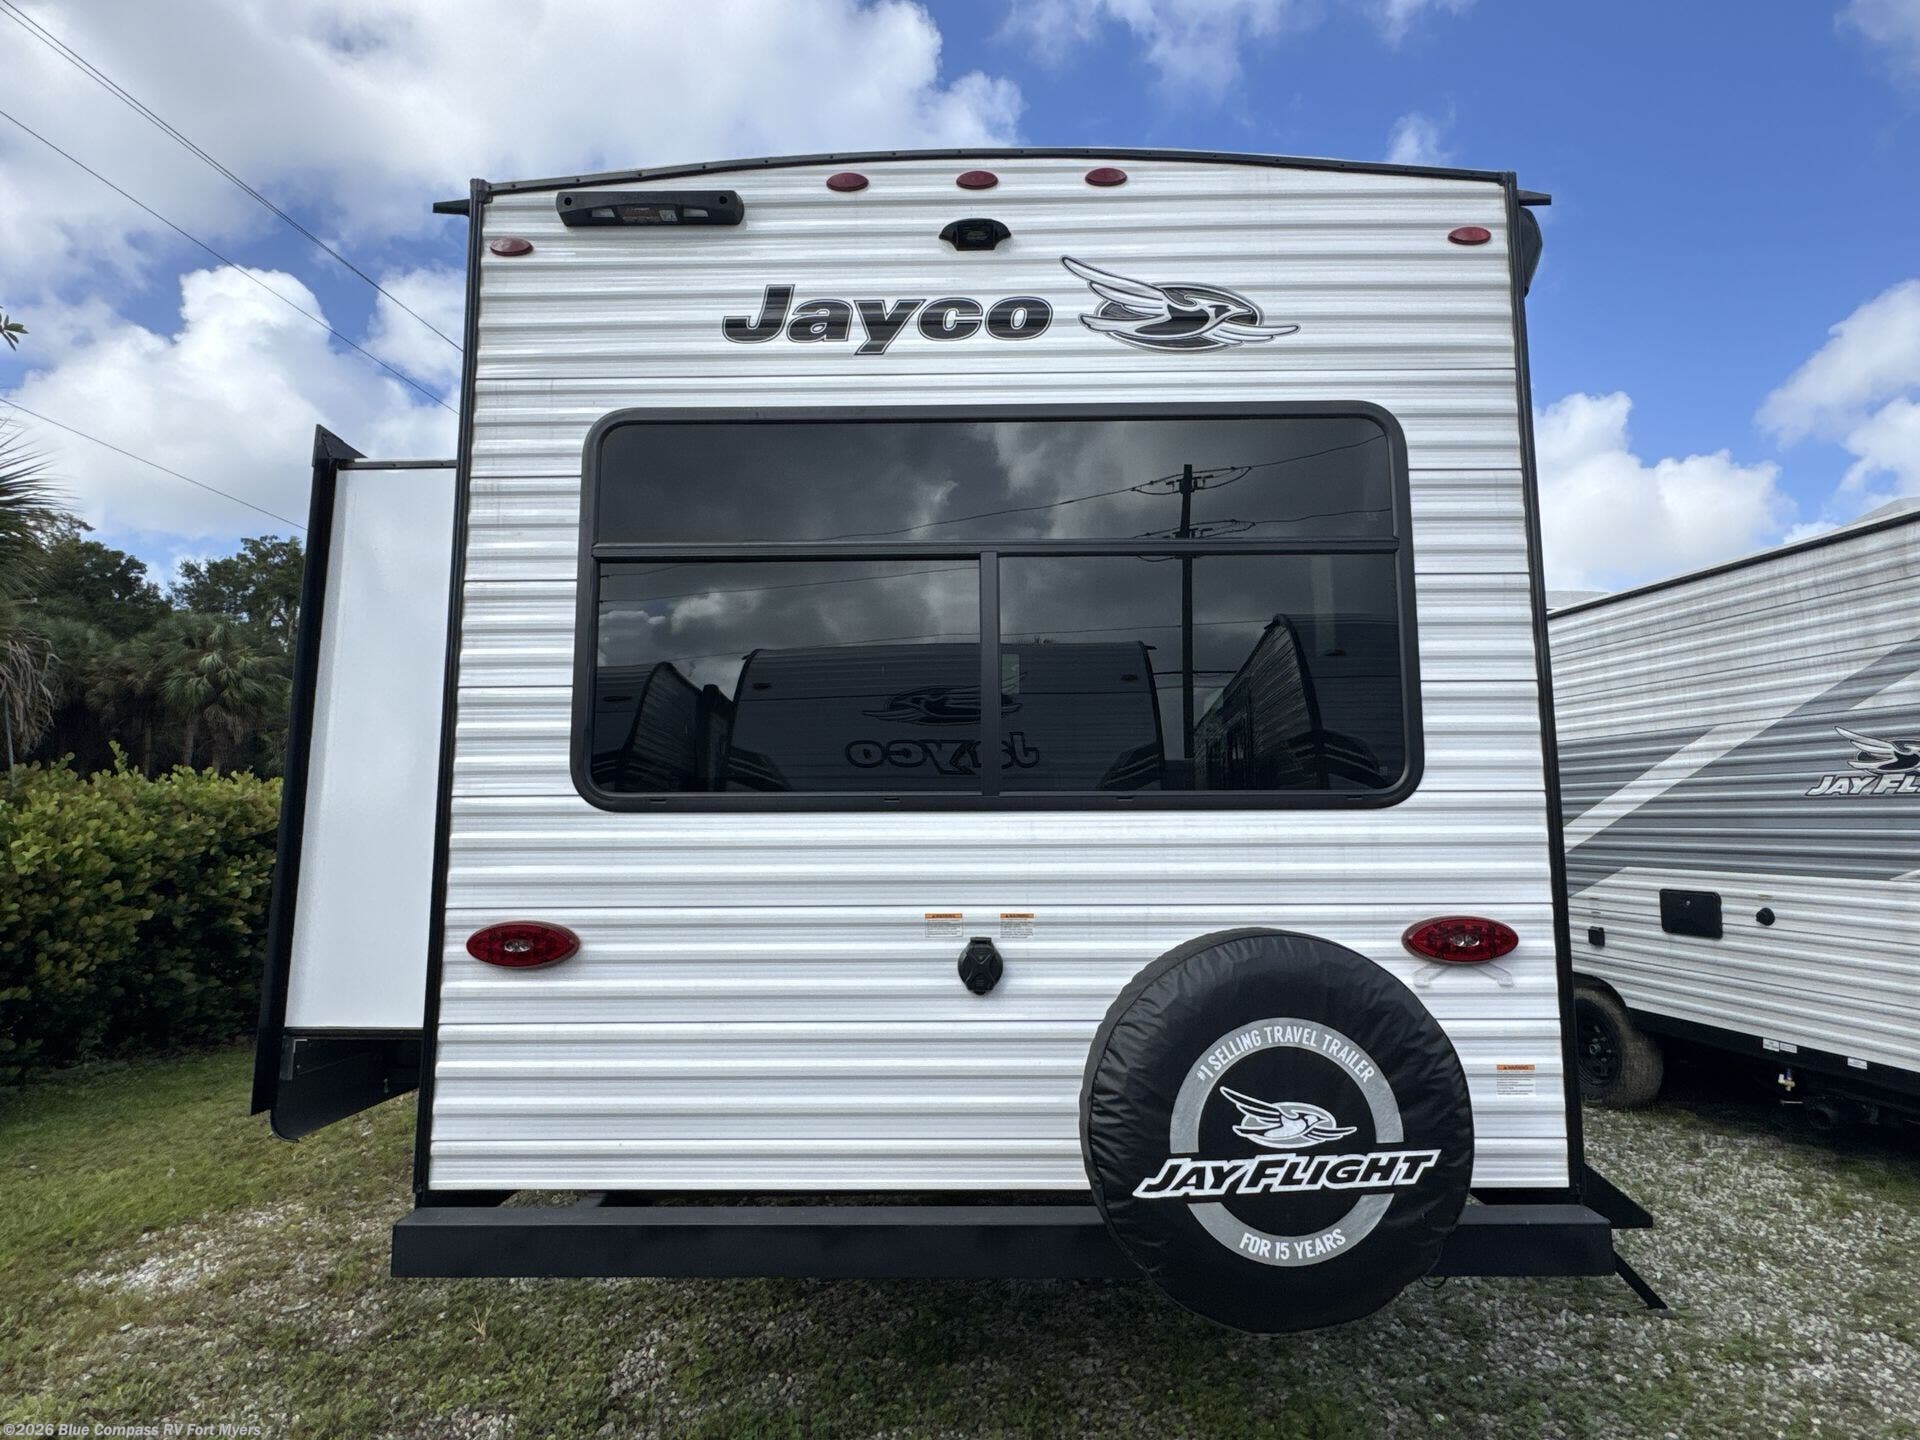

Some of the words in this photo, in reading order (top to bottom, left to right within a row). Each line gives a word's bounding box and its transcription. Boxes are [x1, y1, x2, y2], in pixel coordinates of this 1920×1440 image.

[722, 283, 1053, 356] Jayco
[1871, 774, 1920, 795] FL
[1196, 1064, 1214, 1082] #1
[1208, 1030, 1262, 1071] SELLING
[1263, 1025, 1317, 1047] TRAVEL
[1323, 1034, 1375, 1083] TRAILER
[1239, 1232, 1270, 1259] FOR
[1275, 1242, 1290, 1260] 15
[1294, 1228, 1346, 1260] YEARS
